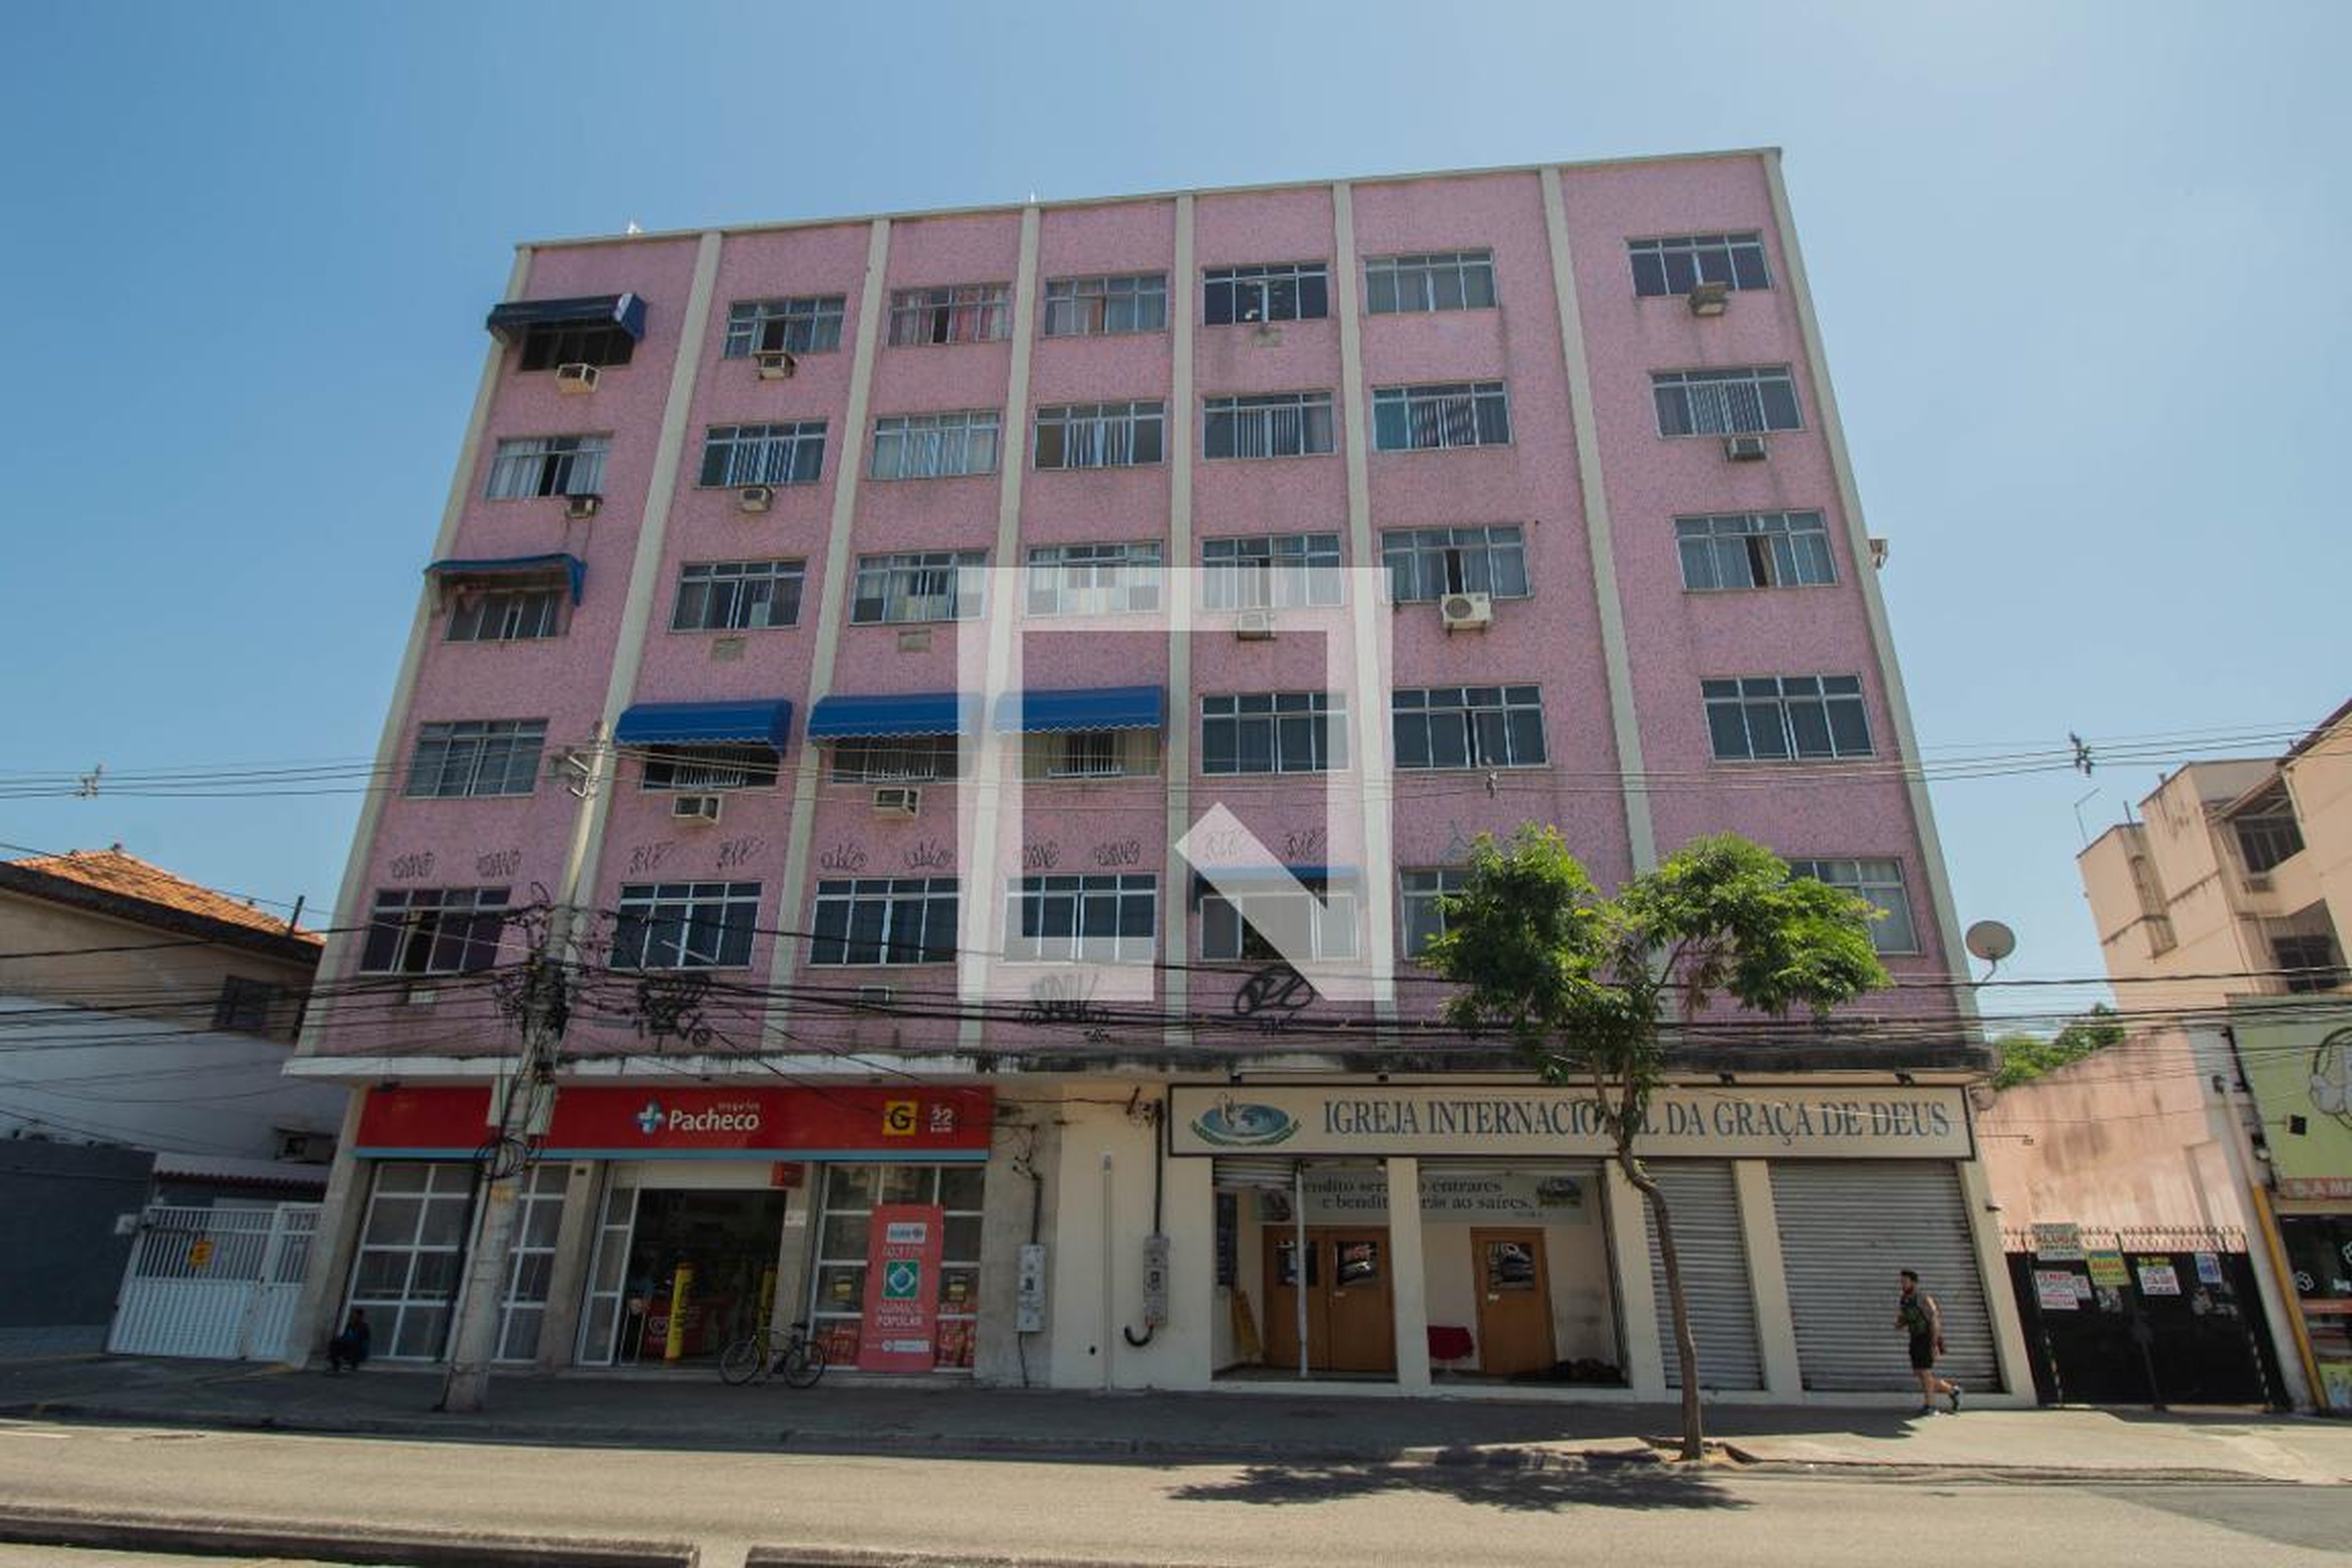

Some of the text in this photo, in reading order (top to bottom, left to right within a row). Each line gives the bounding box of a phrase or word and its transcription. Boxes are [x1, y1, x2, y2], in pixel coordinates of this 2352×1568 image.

[669, 1107, 760, 1131] Pacheco
[1324, 1100, 1950, 1145] IGREJA INTERNACIOL DA GRAÇA DE DEUS
[1288, 1177, 1354, 1193] endito
[1431, 1180, 1503, 1193] entrares
[1336, 1194, 1389, 1210] bendit
[1421, 1195, 1446, 1210] rás
